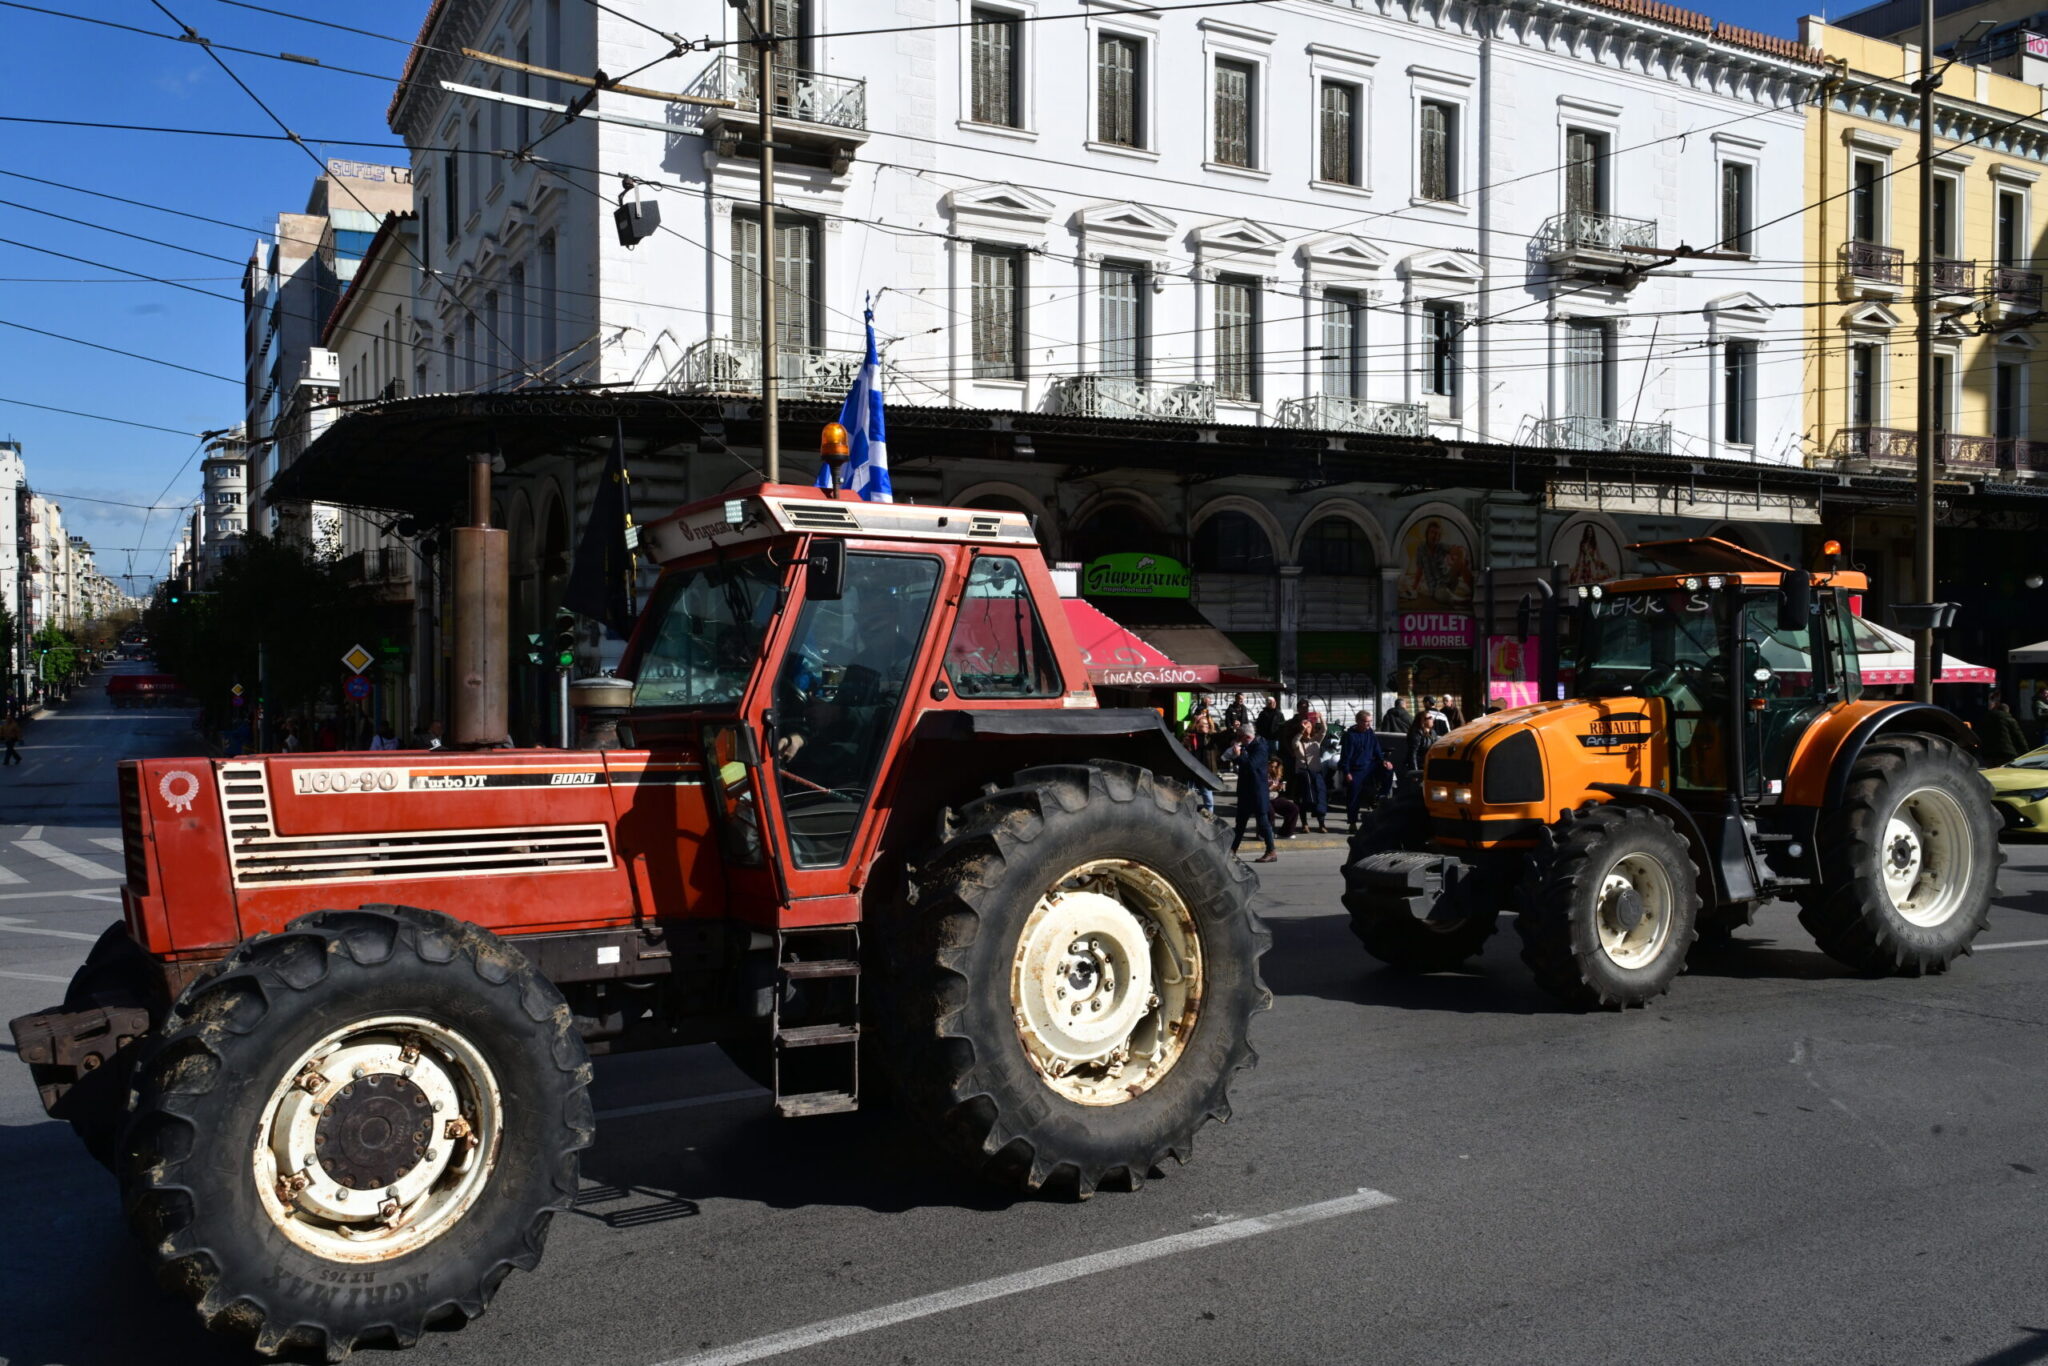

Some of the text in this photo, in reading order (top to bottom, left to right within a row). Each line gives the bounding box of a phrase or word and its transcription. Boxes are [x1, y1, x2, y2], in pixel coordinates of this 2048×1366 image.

[1404, 614, 1468, 632] OUTLET
[1404, 634, 1468, 647] LA MORREL
[1589, 721, 1641, 735] RENAULT
[1586, 736, 1617, 746] Ares
[299, 769, 487, 793] 160-90 Turbo DT
[551, 773, 596, 785] FIAT
[261, 1265, 430, 1311] AGRI MAX
